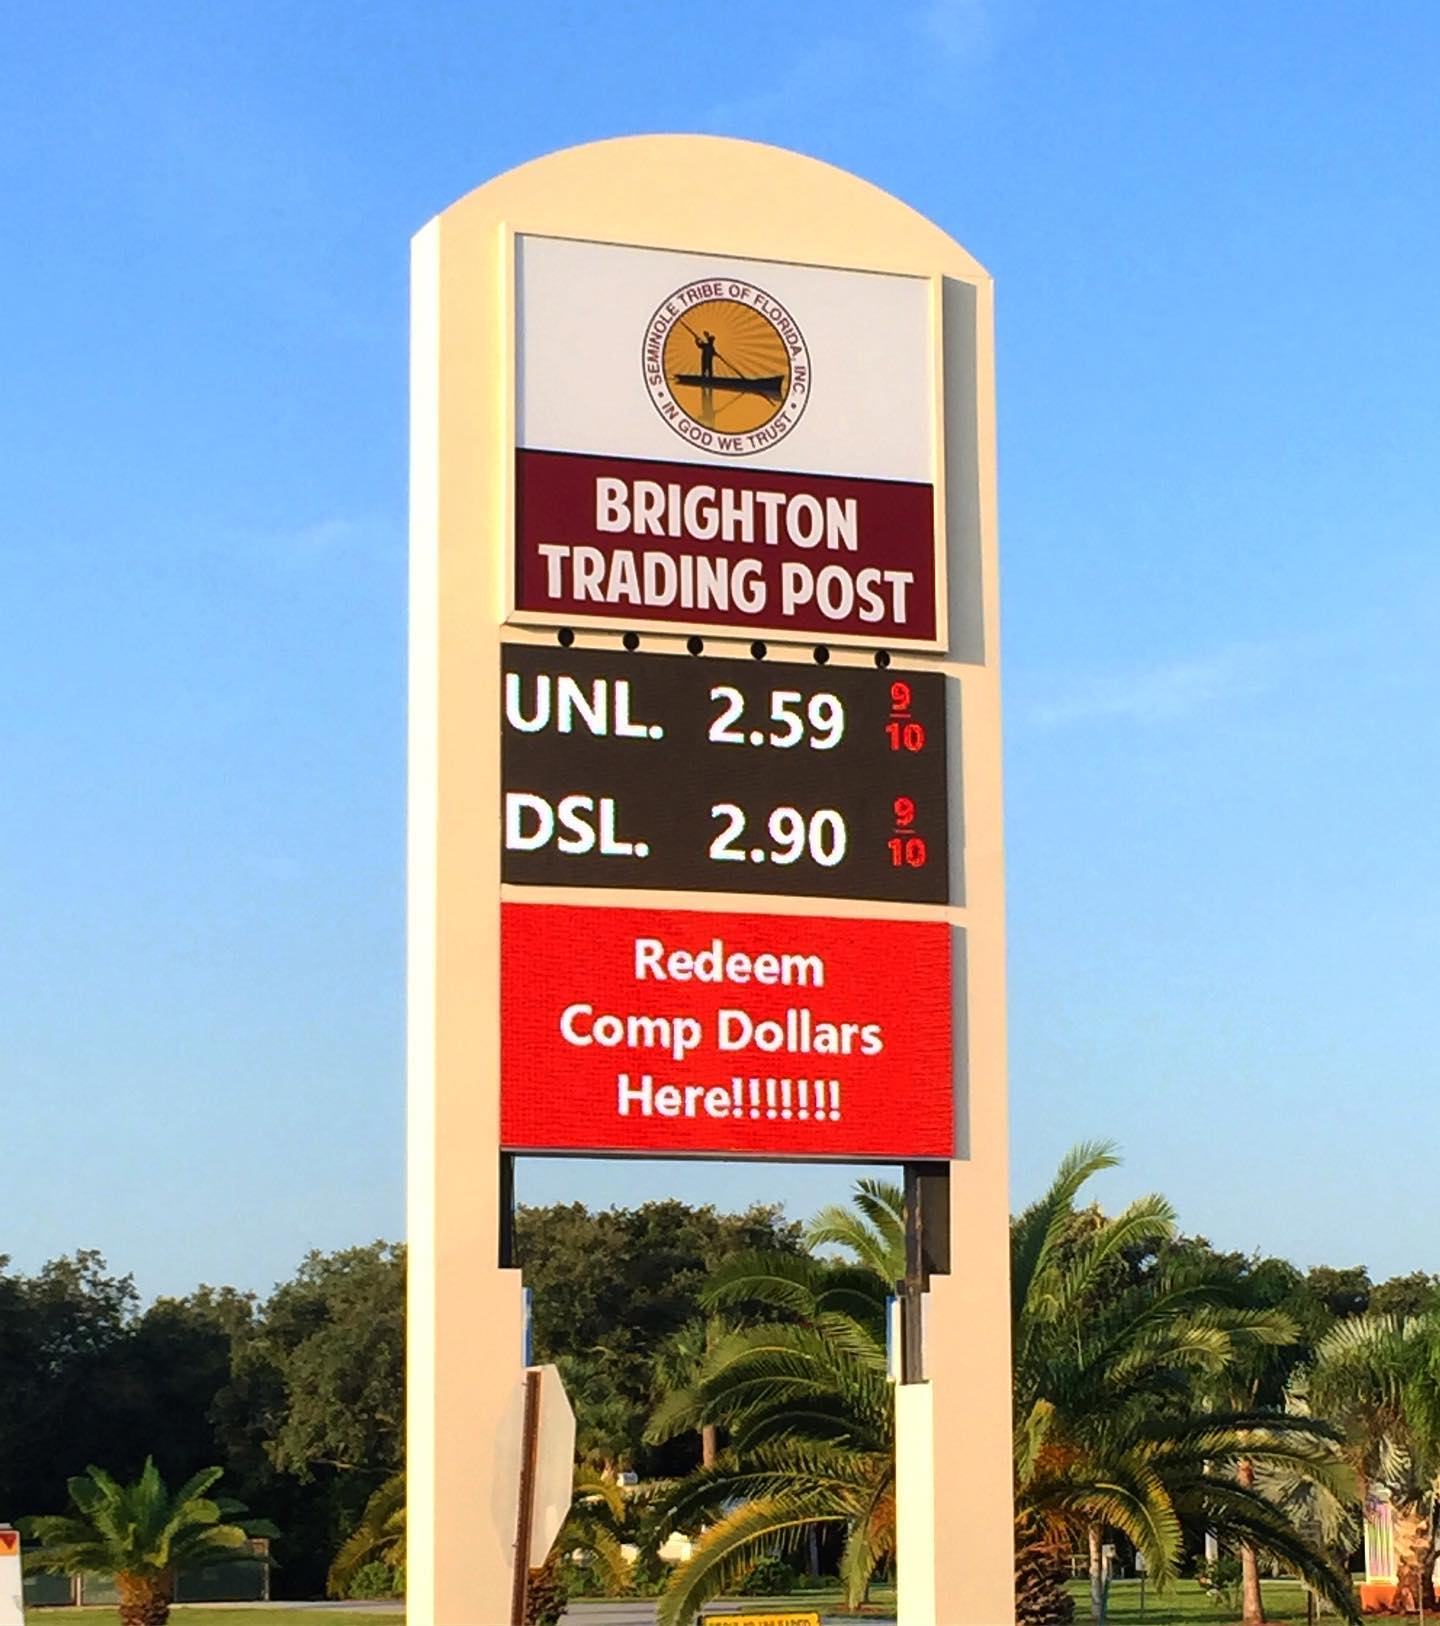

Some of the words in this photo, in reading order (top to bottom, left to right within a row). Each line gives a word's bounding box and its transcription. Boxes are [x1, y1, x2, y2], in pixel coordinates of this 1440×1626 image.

[648, 302, 680, 386] SEMINOLE
[677, 282, 724, 307] TRIBE
[728, 284, 751, 300] OF
[661, 400, 680, 420] IN
[678, 418, 713, 447] GOD
[717, 436, 744, 451] WE
[747, 411, 793, 449] TRUST
[596, 477, 858, 551] BRIGHTON
[538, 543, 767, 615] TRADING
[781, 561, 914, 624] POST
[505, 672, 665, 740] UNL.
[708, 686, 845, 750] 2.59
[890, 682, 912, 711] 9
[885, 722, 925, 752] 10
[505, 792, 650, 858] DSL.
[708, 803, 847, 867] 2.90
[893, 797, 915, 827] 9
[888, 837, 927, 868] 10
[634, 938, 824, 987] Redeem
[560, 1004, 701, 1060] Comp
[718, 1008, 883, 1055] Dollars
[617, 1073, 841, 1121] Here!!!!!!!
